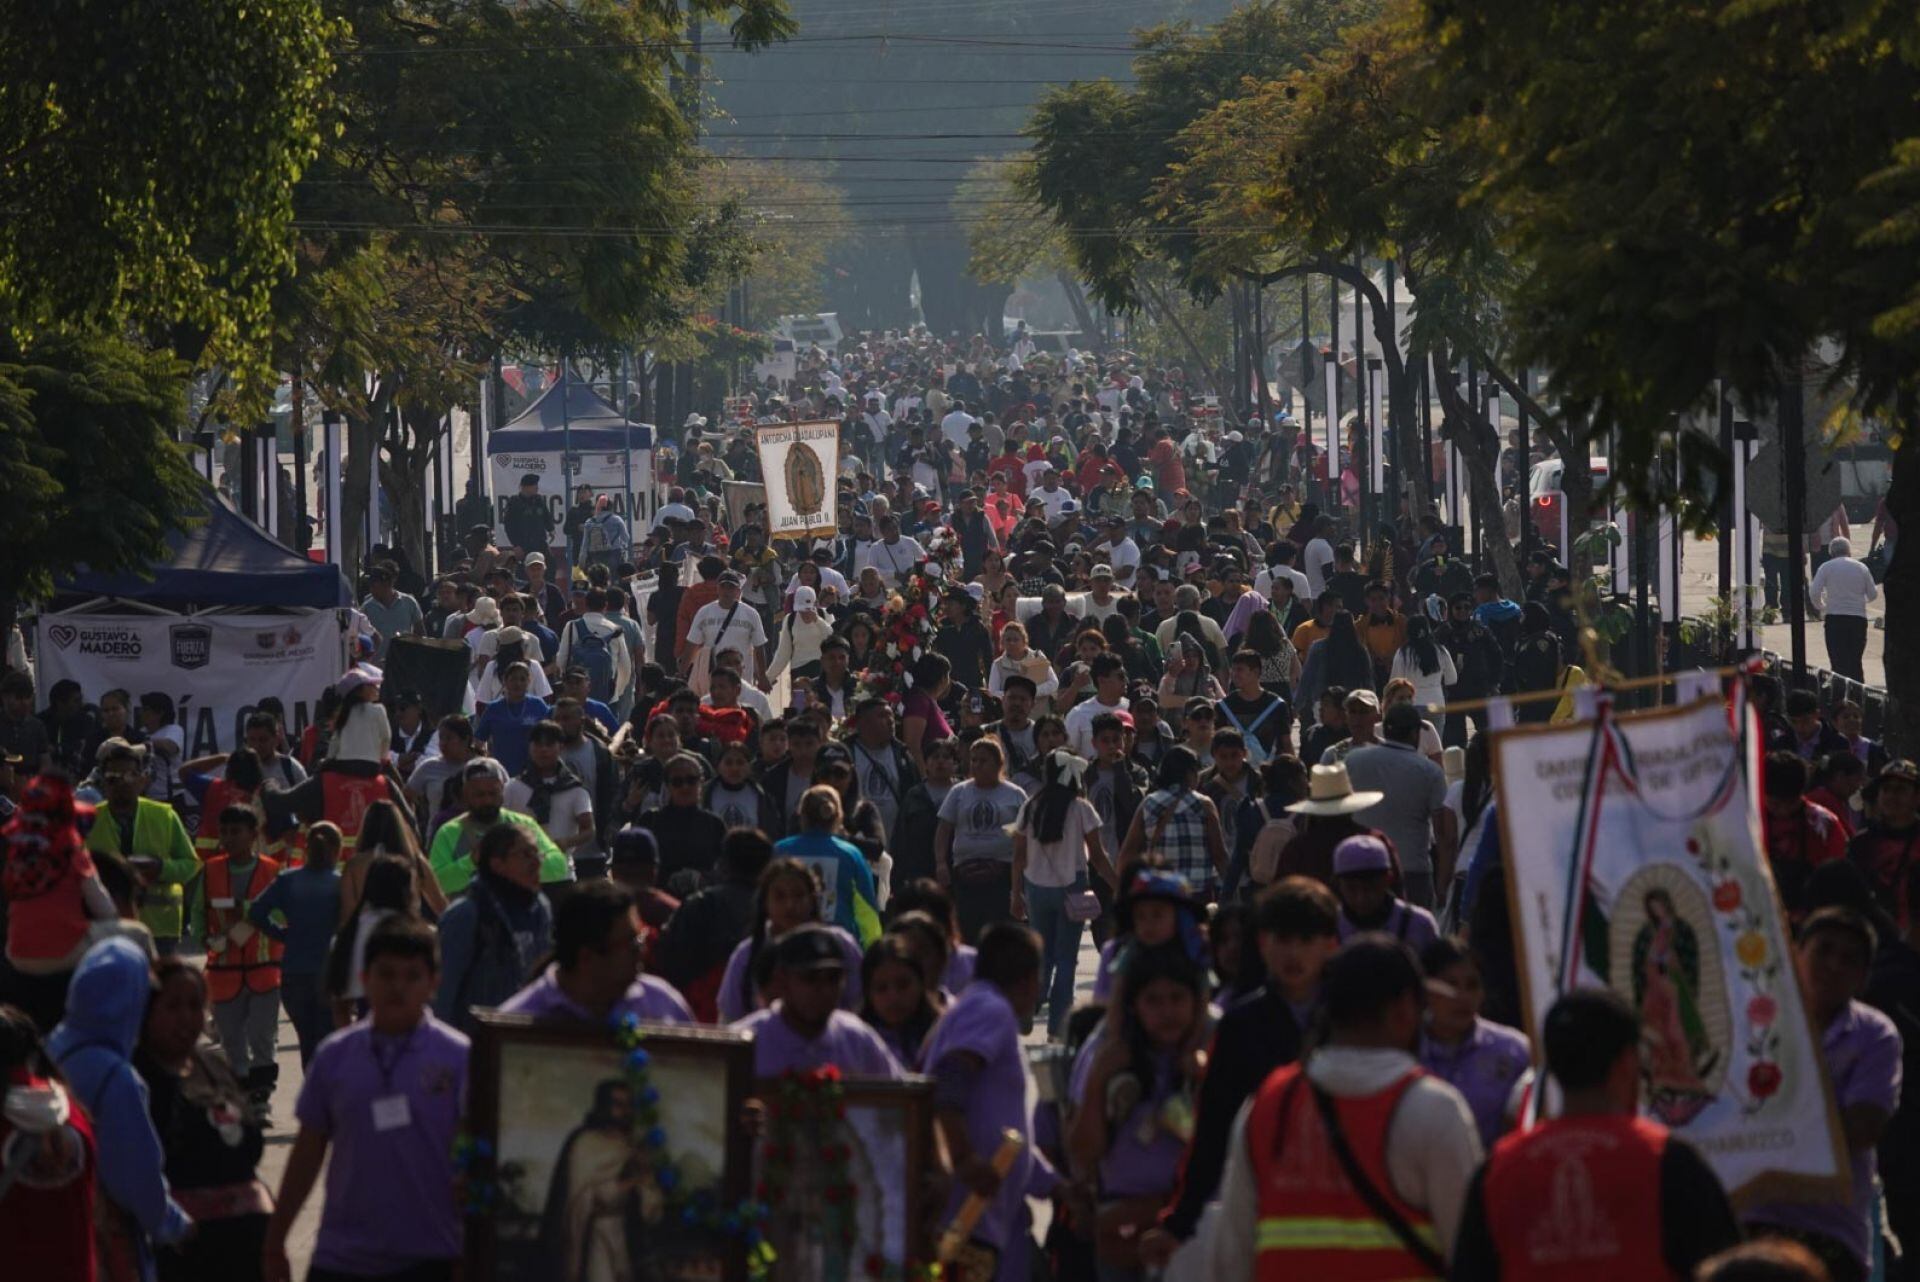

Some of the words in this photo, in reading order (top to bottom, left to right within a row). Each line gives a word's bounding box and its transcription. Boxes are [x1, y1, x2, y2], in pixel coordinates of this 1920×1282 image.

[761, 431, 792, 445] ANTORCHA
[780, 515, 798, 527] JUAN
[80, 631, 128, 641] GUSTAVO
[130, 632, 141, 642] A.
[79, 642, 142, 654] MADERO
[176, 640, 205, 655] FUERZA
